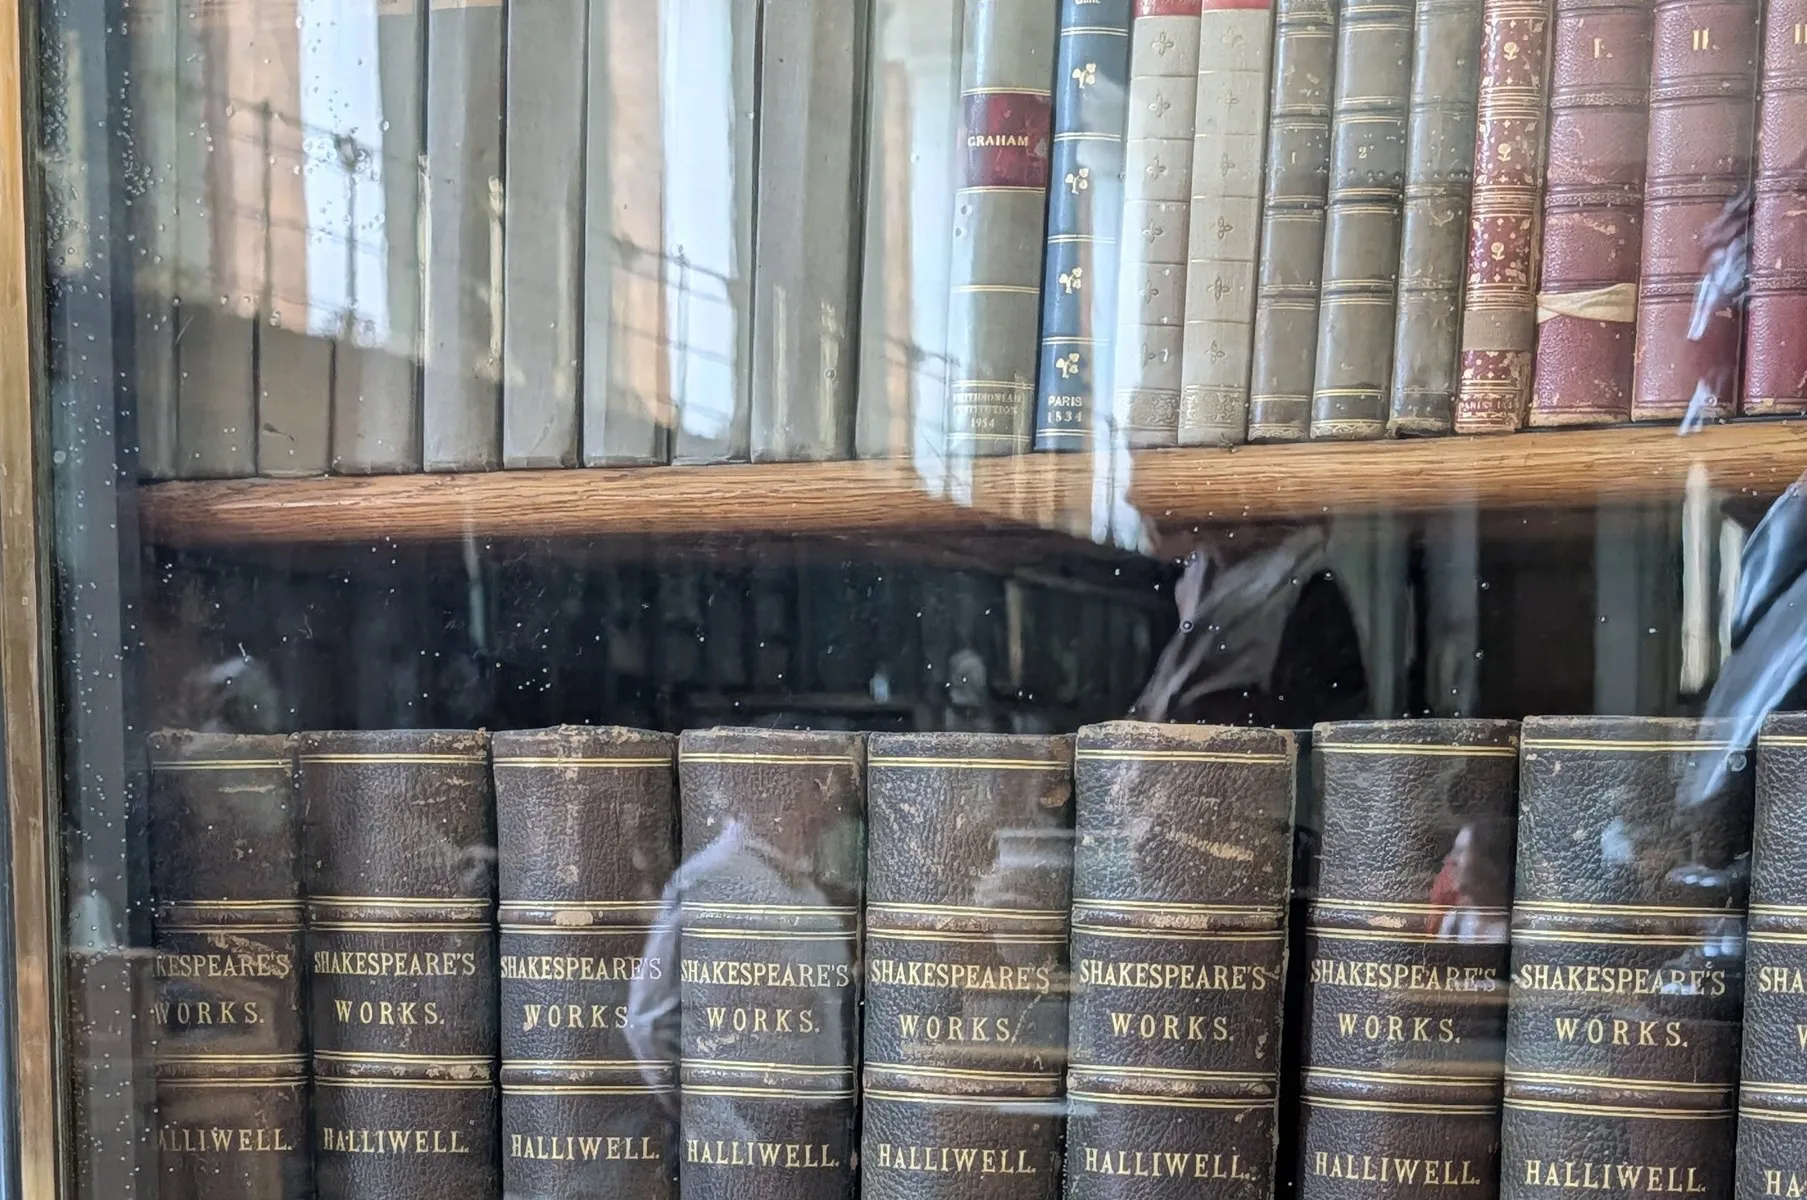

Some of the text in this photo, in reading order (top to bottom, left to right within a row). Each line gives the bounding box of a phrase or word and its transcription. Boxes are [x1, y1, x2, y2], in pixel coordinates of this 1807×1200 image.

[968, 135, 1029, 147] GRAHAM
[1048, 395, 1083, 407] PARIS
[314, 951, 476, 976] SHAKESPEARE'S
[500, 955, 663, 981] SHAKESPEARE'S
[681, 958, 850, 987] SHAKESPEARE'S
[871, 959, 1050, 990] SHAKESPEARE'S
[1079, 958, 1267, 991] SHAKESPEARE'S
[1310, 959, 1497, 992] SHAKESPEARE'S
[1520, 964, 1726, 996] SHAKESPEARE'S
[154, 1001, 264, 1025] WORKS.
[335, 1000, 445, 1025] WORKS.
[524, 1004, 634, 1030] WORKS.
[707, 1007, 820, 1033] WORKS.
[1110, 1012, 1235, 1041] WORKS.
[900, 1013, 1016, 1042] WORKS.
[1339, 1013, 1460, 1043] WORKS.
[1555, 1017, 1688, 1047] WORKS.
[323, 1127, 470, 1154] HALLIWELL.
[511, 1133, 660, 1160] HALLIWELL.
[686, 1139, 840, 1167] HALLIWELL.
[878, 1143, 1037, 1174] HALLIWELL.
[1085, 1147, 1251, 1179] HALLIWELL.
[1315, 1152, 1480, 1185] HALLIWELL.
[1525, 1159, 1706, 1193] HALLIWELL.
